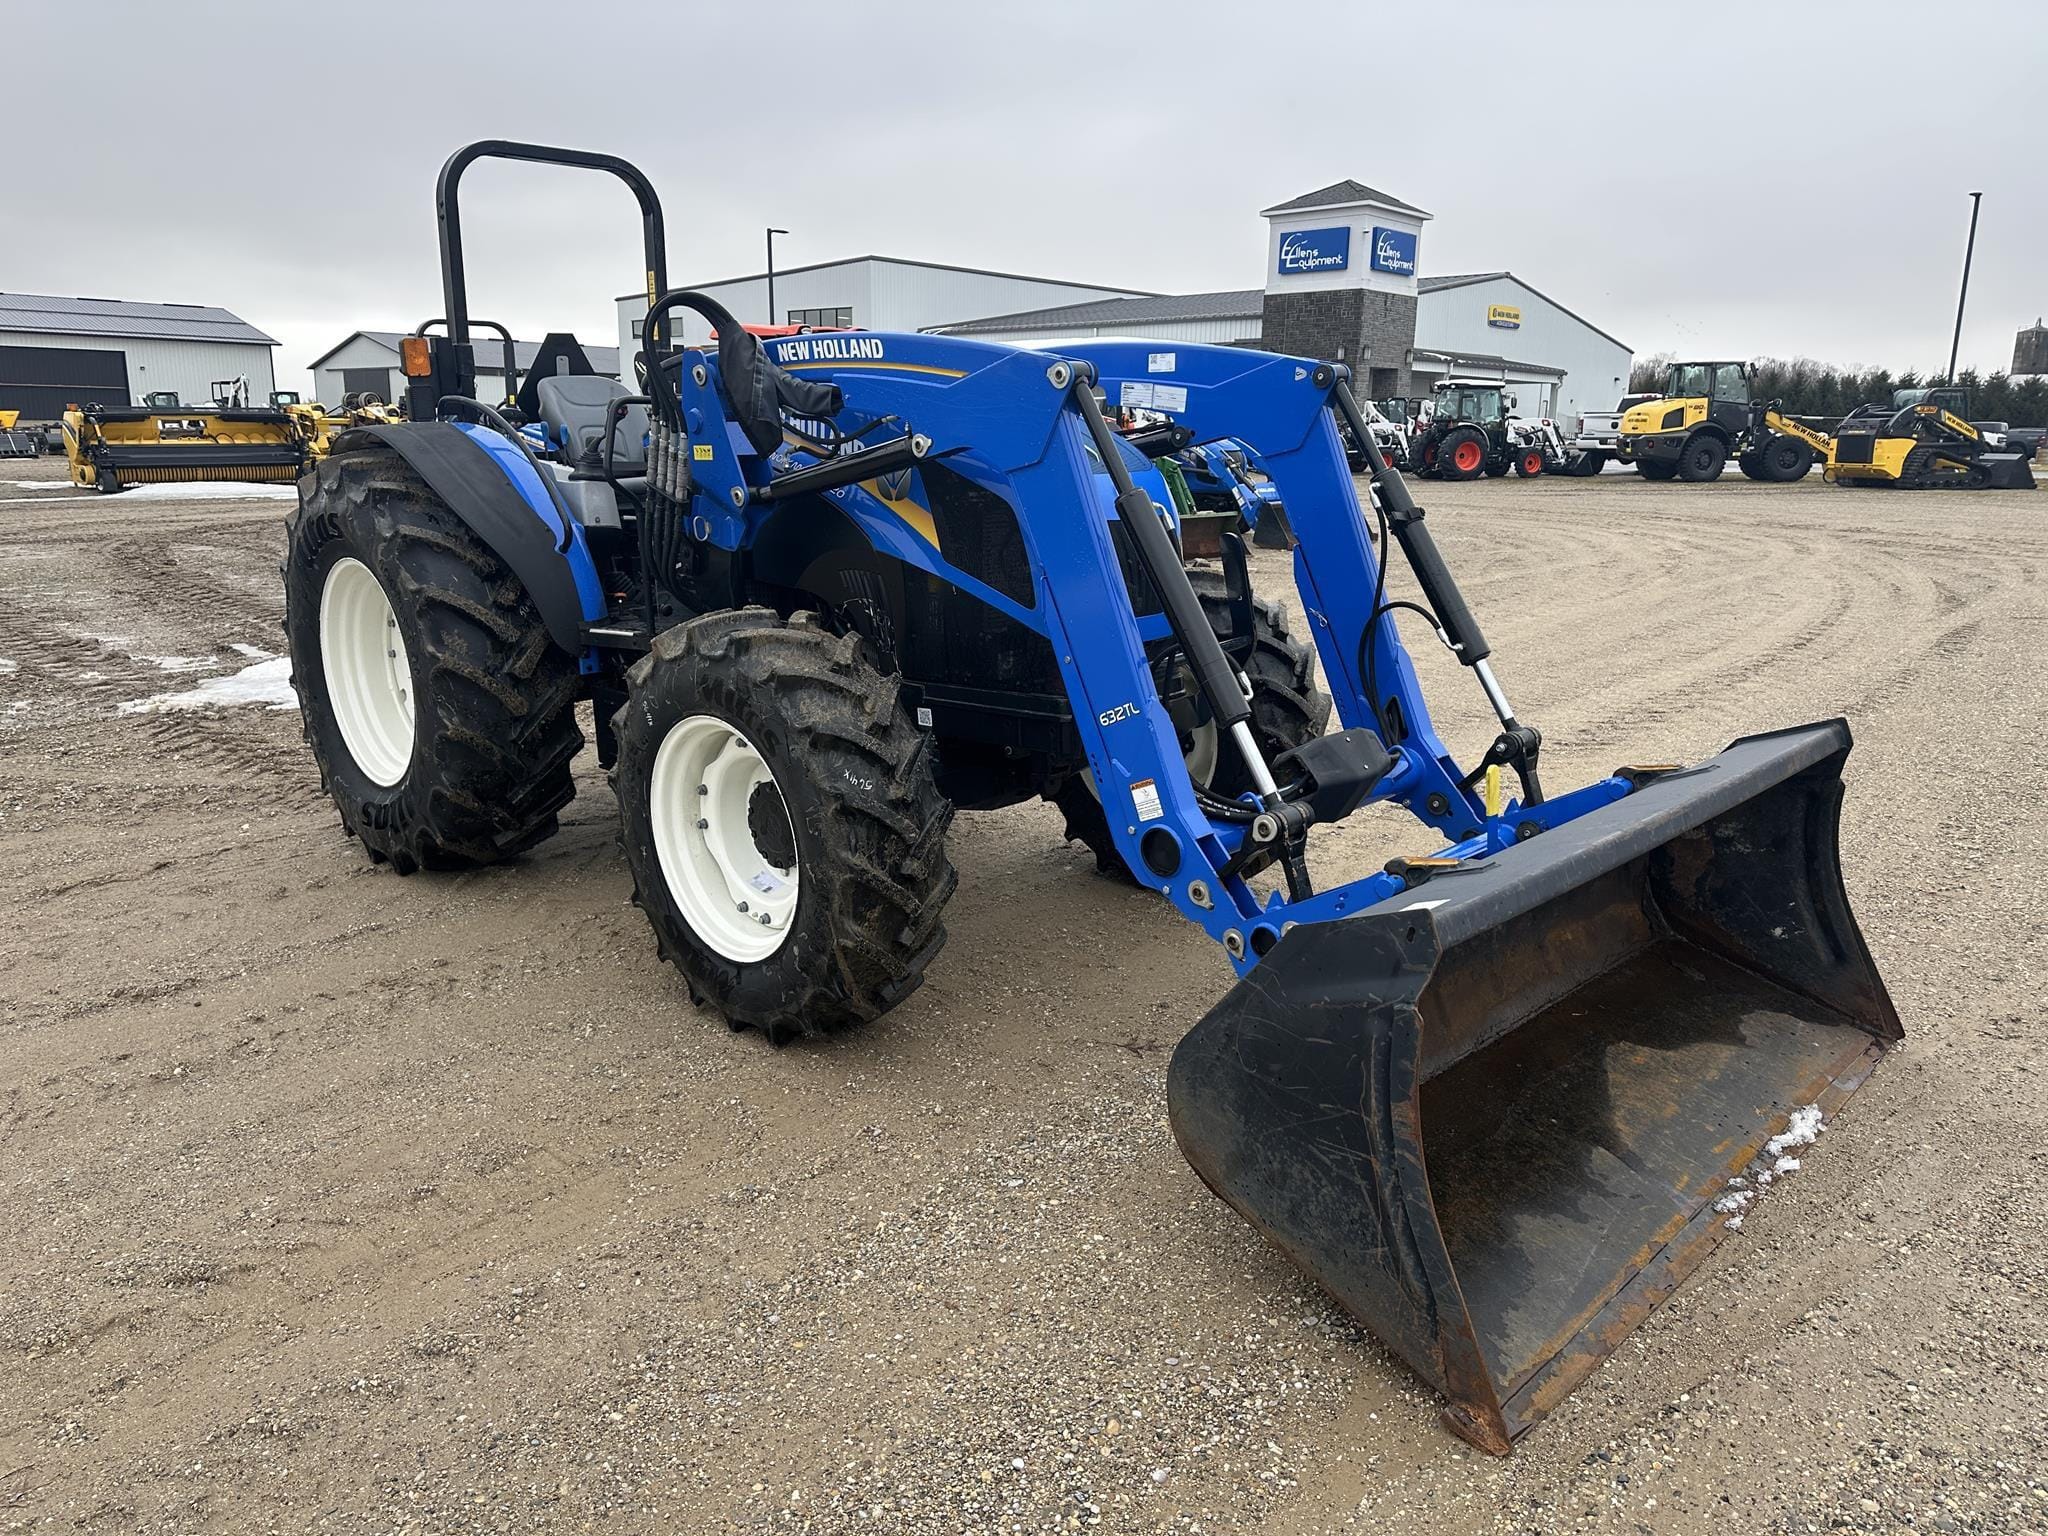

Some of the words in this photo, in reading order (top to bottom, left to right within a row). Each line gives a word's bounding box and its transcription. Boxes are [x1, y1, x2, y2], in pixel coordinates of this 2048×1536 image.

[1281, 233, 1319, 259] Ellens
[1286, 241, 1343, 269] Equipment
[1378, 231, 1401, 258] Ellens
[1381, 241, 1413, 271] Equipment
[777, 341, 809, 362] NEW
[812, 339, 883, 360] HOLLAND
[1792, 423, 1807, 434] NEW
[1807, 432, 1831, 448] HOLLAN
[1099, 702, 1140, 726] 632TL
